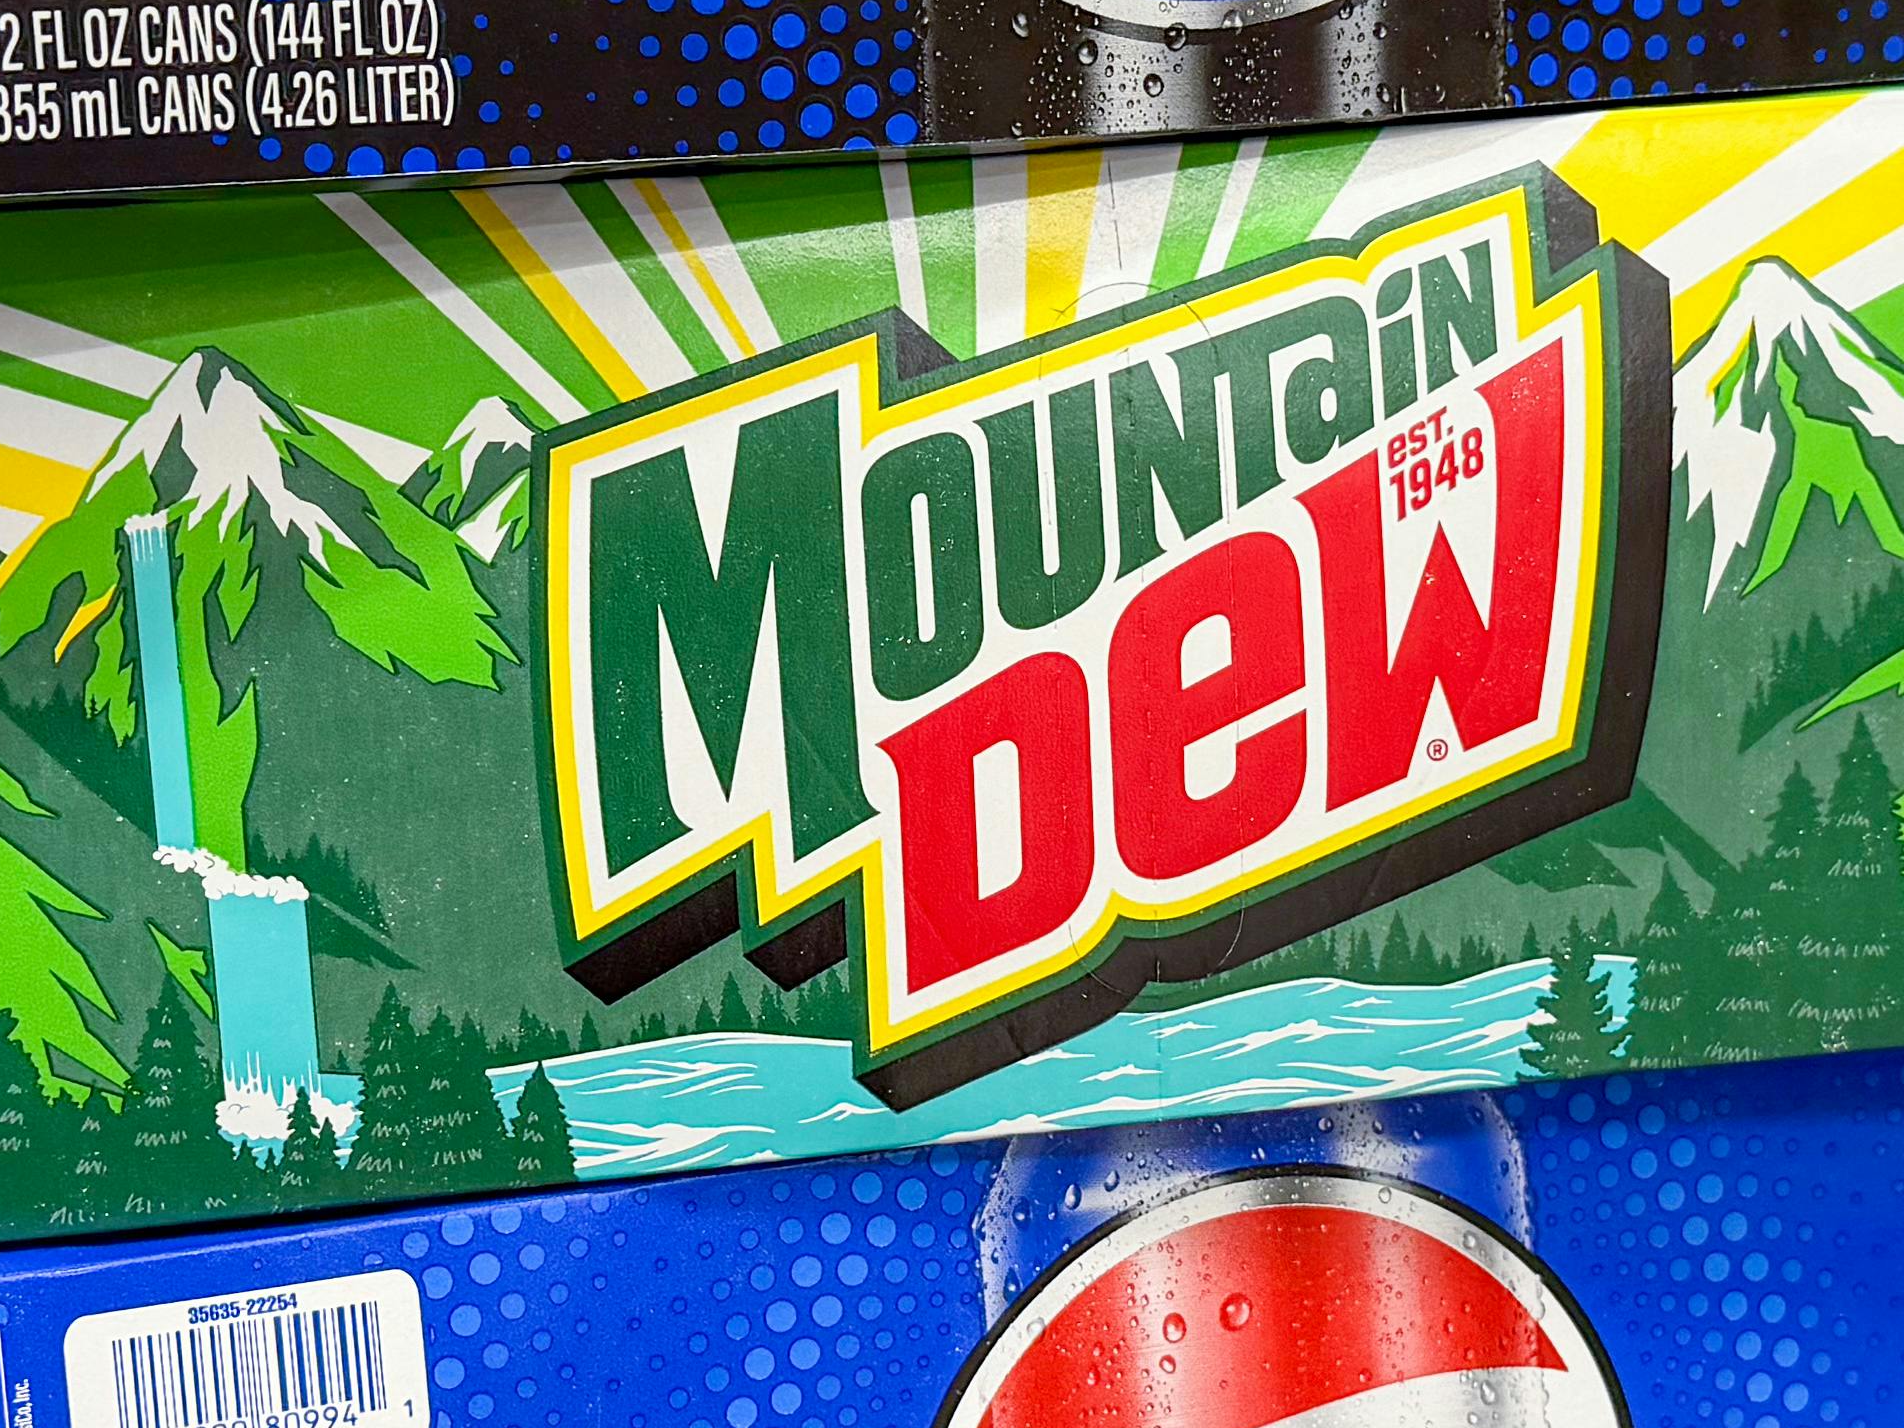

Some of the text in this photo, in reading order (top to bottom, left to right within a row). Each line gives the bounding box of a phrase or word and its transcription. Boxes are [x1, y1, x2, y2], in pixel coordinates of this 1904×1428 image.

[32, 9, 77, 70] FL
[83, 7, 132, 68] OZ
[141, 1, 237, 65] CANS
[71, 77, 132, 139] mL
[138, 71, 237, 135] CANS
[245, 66, 338, 136] (4.26
[346, 57, 457, 125] LITER)
[1388, 425, 1485, 524] 1948
